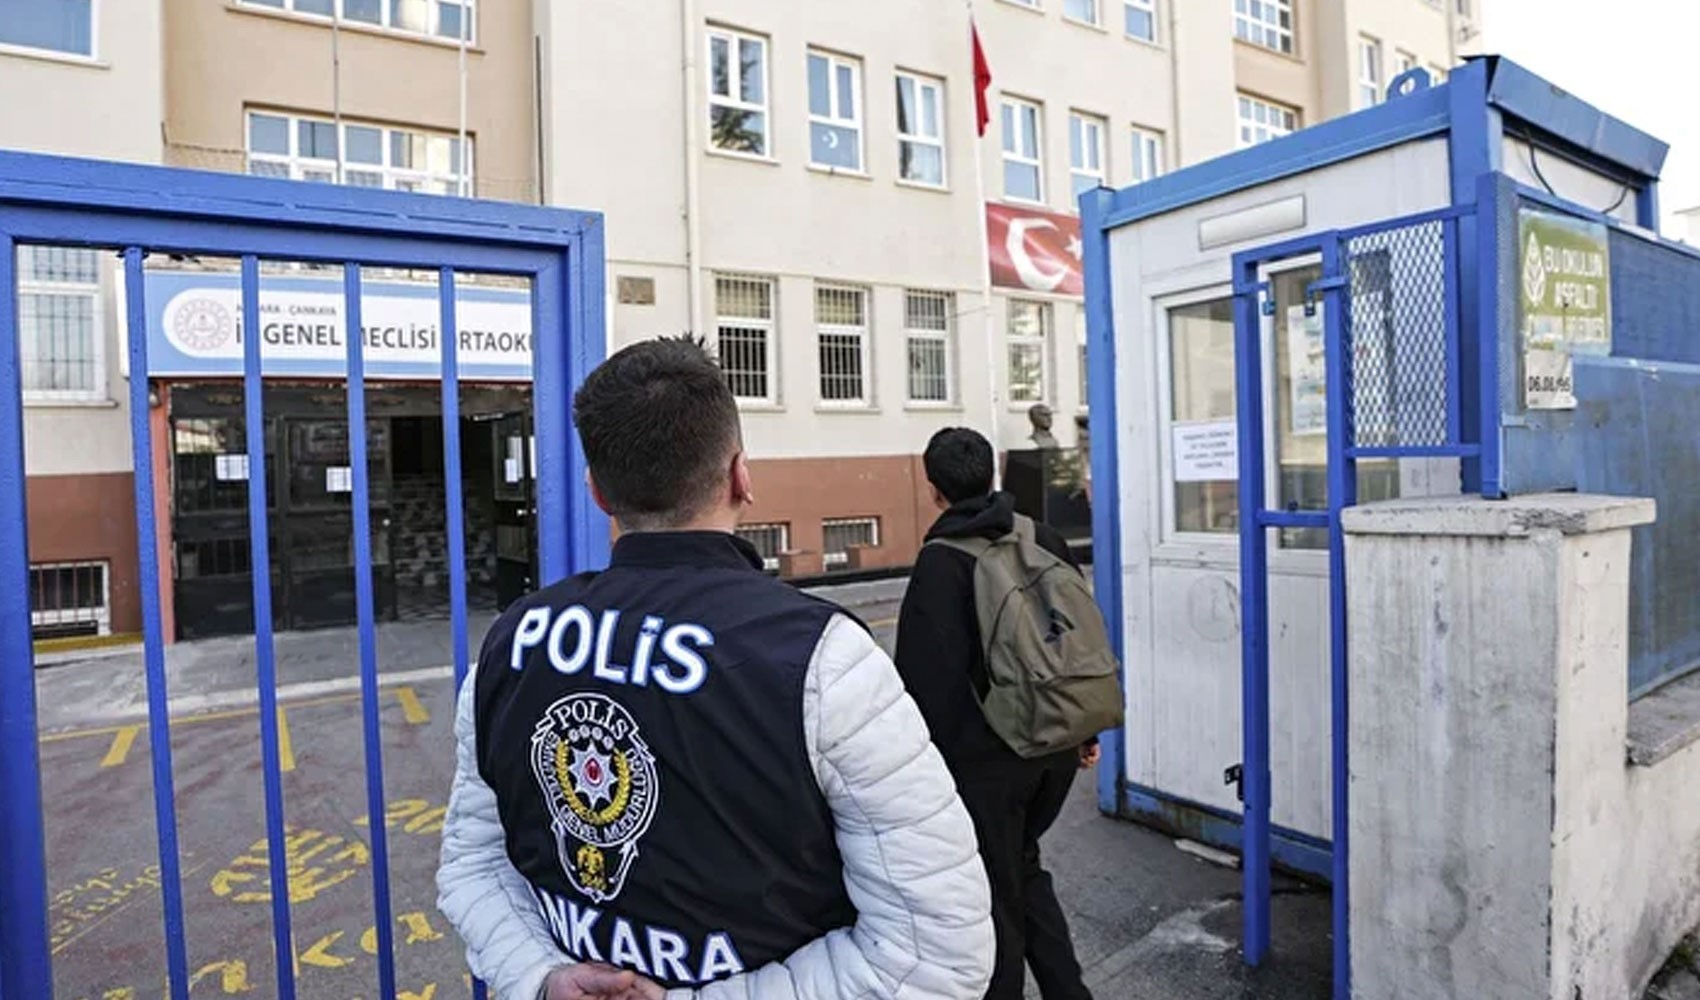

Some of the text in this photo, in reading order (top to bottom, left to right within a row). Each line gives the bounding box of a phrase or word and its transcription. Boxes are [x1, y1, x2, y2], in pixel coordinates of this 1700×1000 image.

[289, 305, 337, 316] ÇANKAYA
[263, 322, 342, 346] GENEL
[459, 330, 533, 352] RTAOK
[510, 604, 715, 694] POLİS
[553, 699, 630, 741] POLİS
[536, 886, 744, 982] NKARA
